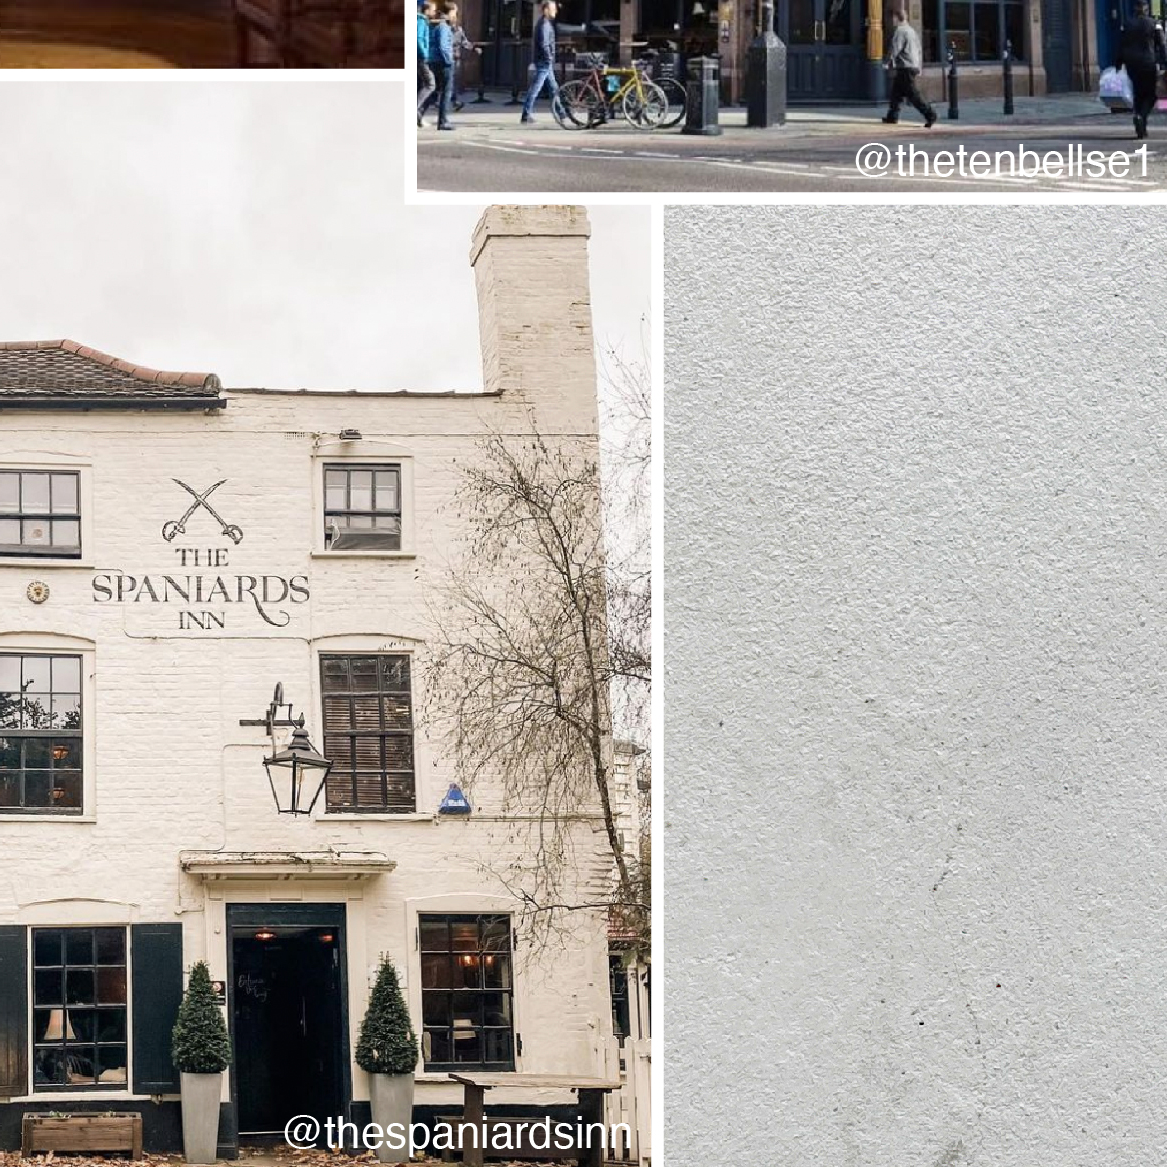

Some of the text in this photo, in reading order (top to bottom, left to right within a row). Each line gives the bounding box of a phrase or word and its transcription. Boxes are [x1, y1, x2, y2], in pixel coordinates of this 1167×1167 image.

[175, 548, 229, 567] THE
[91, 575, 311, 627] SPANIARDS
[178, 611, 226, 630] INN
